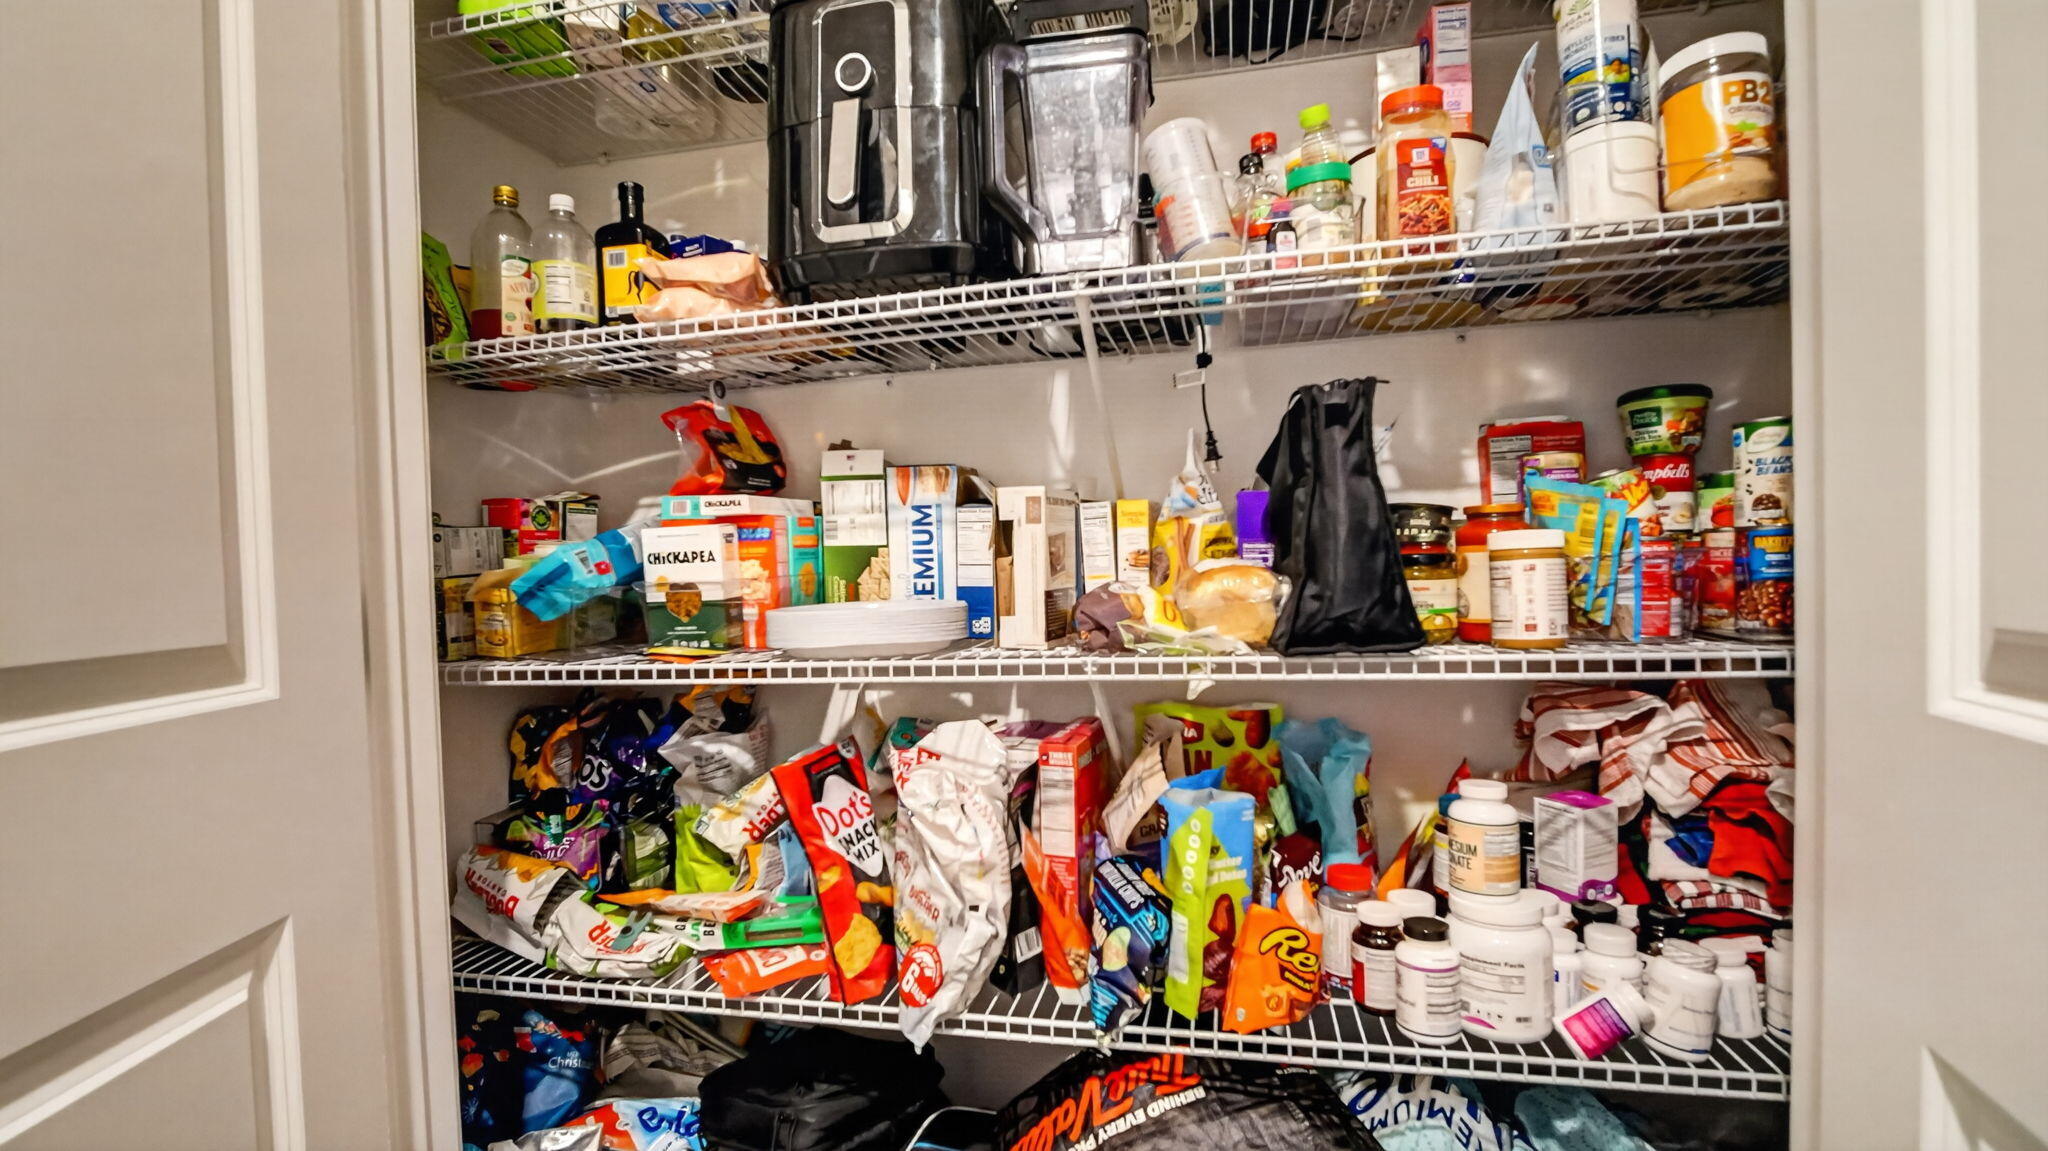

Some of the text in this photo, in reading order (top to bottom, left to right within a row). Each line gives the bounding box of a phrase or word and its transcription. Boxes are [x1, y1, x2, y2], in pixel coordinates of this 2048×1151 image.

[1722, 79, 1771, 104] PB2
[1406, 174, 1439, 188] CHILI
[1643, 463, 1690, 482] mpbell's
[911, 504, 935, 600] EMIUM
[816, 791, 875, 837] Dot's
[839, 819, 879, 855] NACK
[853, 839, 880, 861] MIX
[548, 1055, 588, 1069] Christ
[1010, 1075, 1134, 1151] Valu
[1147, 1085, 1207, 1118] BEHIND
[1097, 1107, 1147, 1145] EVERY
[1361, 1098, 1475, 1151] EMIUM
